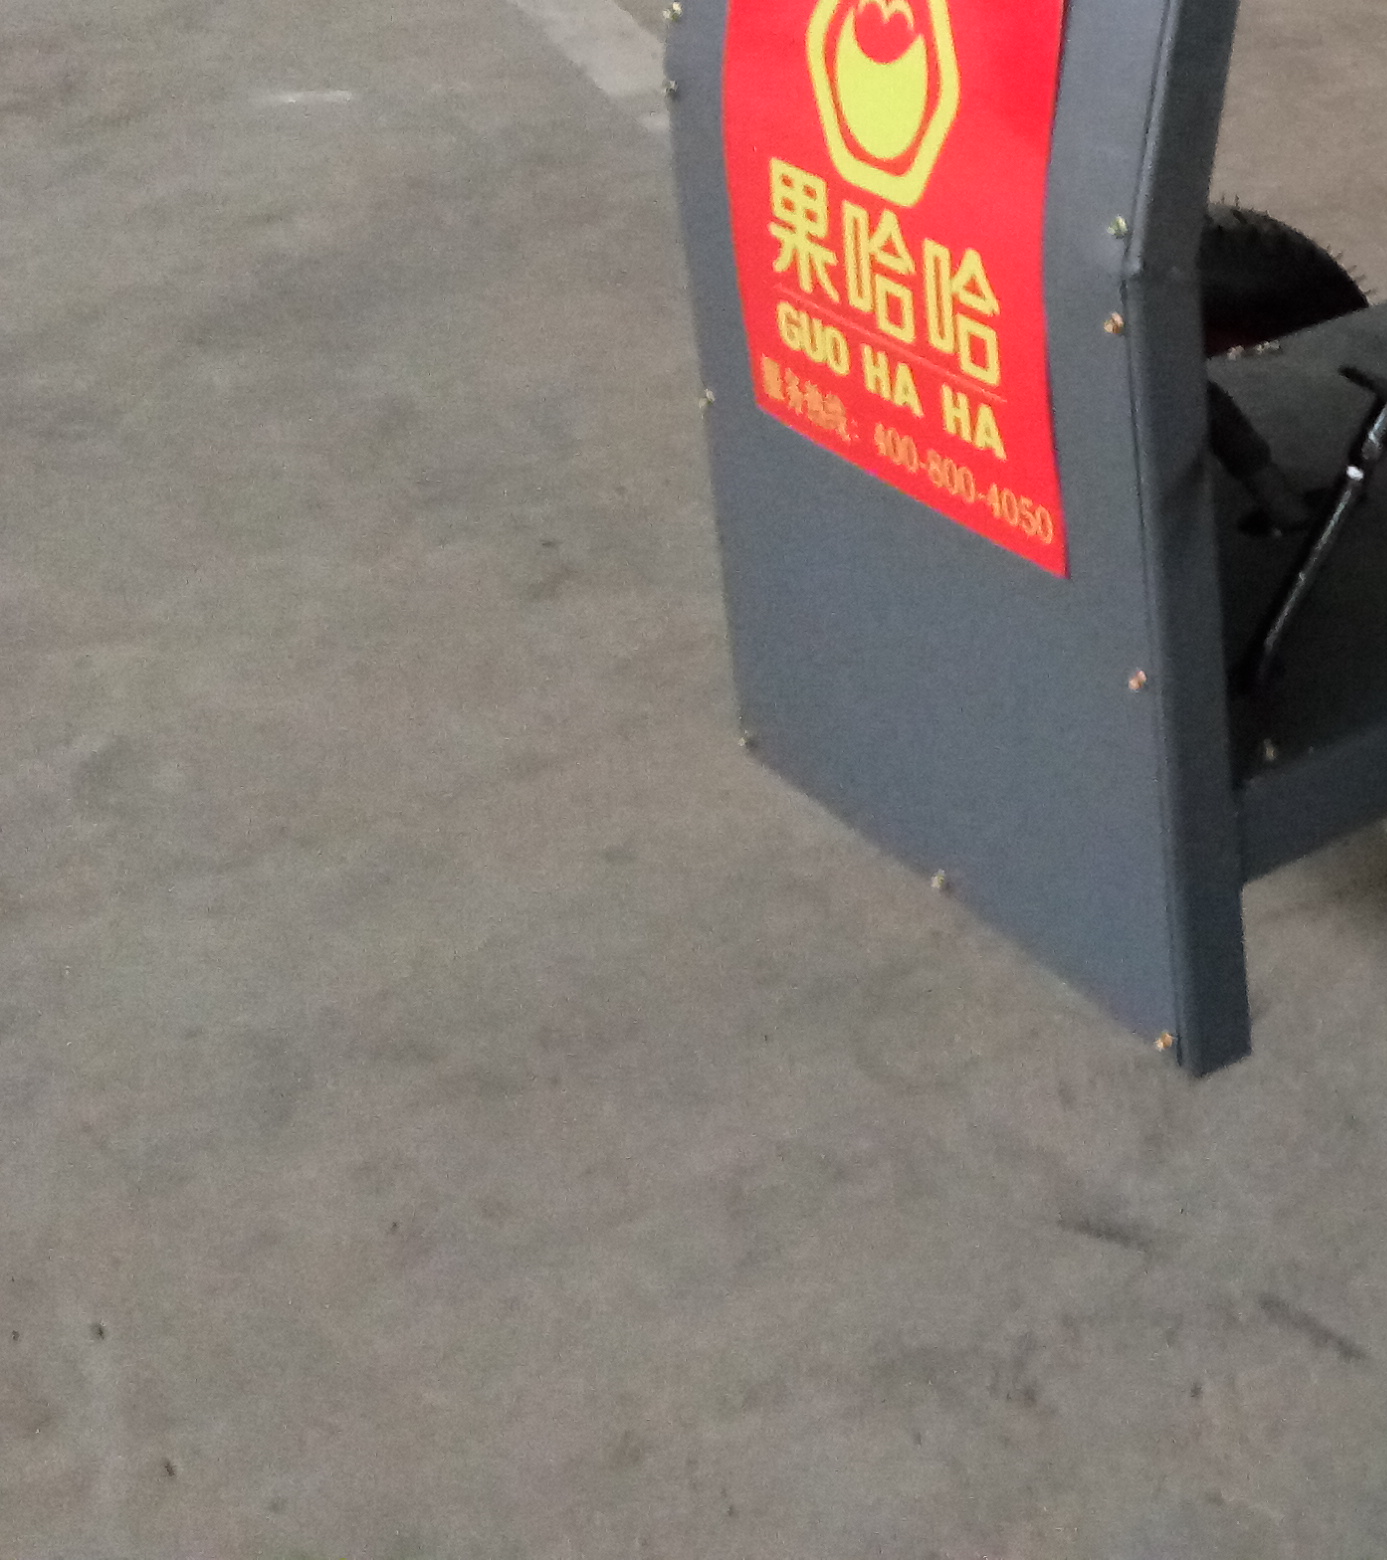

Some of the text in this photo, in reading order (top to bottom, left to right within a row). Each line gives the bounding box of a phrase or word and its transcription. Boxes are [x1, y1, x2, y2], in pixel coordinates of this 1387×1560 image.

[768, 156, 1002, 387] 果哈哈
[776, 300, 1007, 461] GUO HA HA
[873, 422, 1056, 545] 400-800-4050
